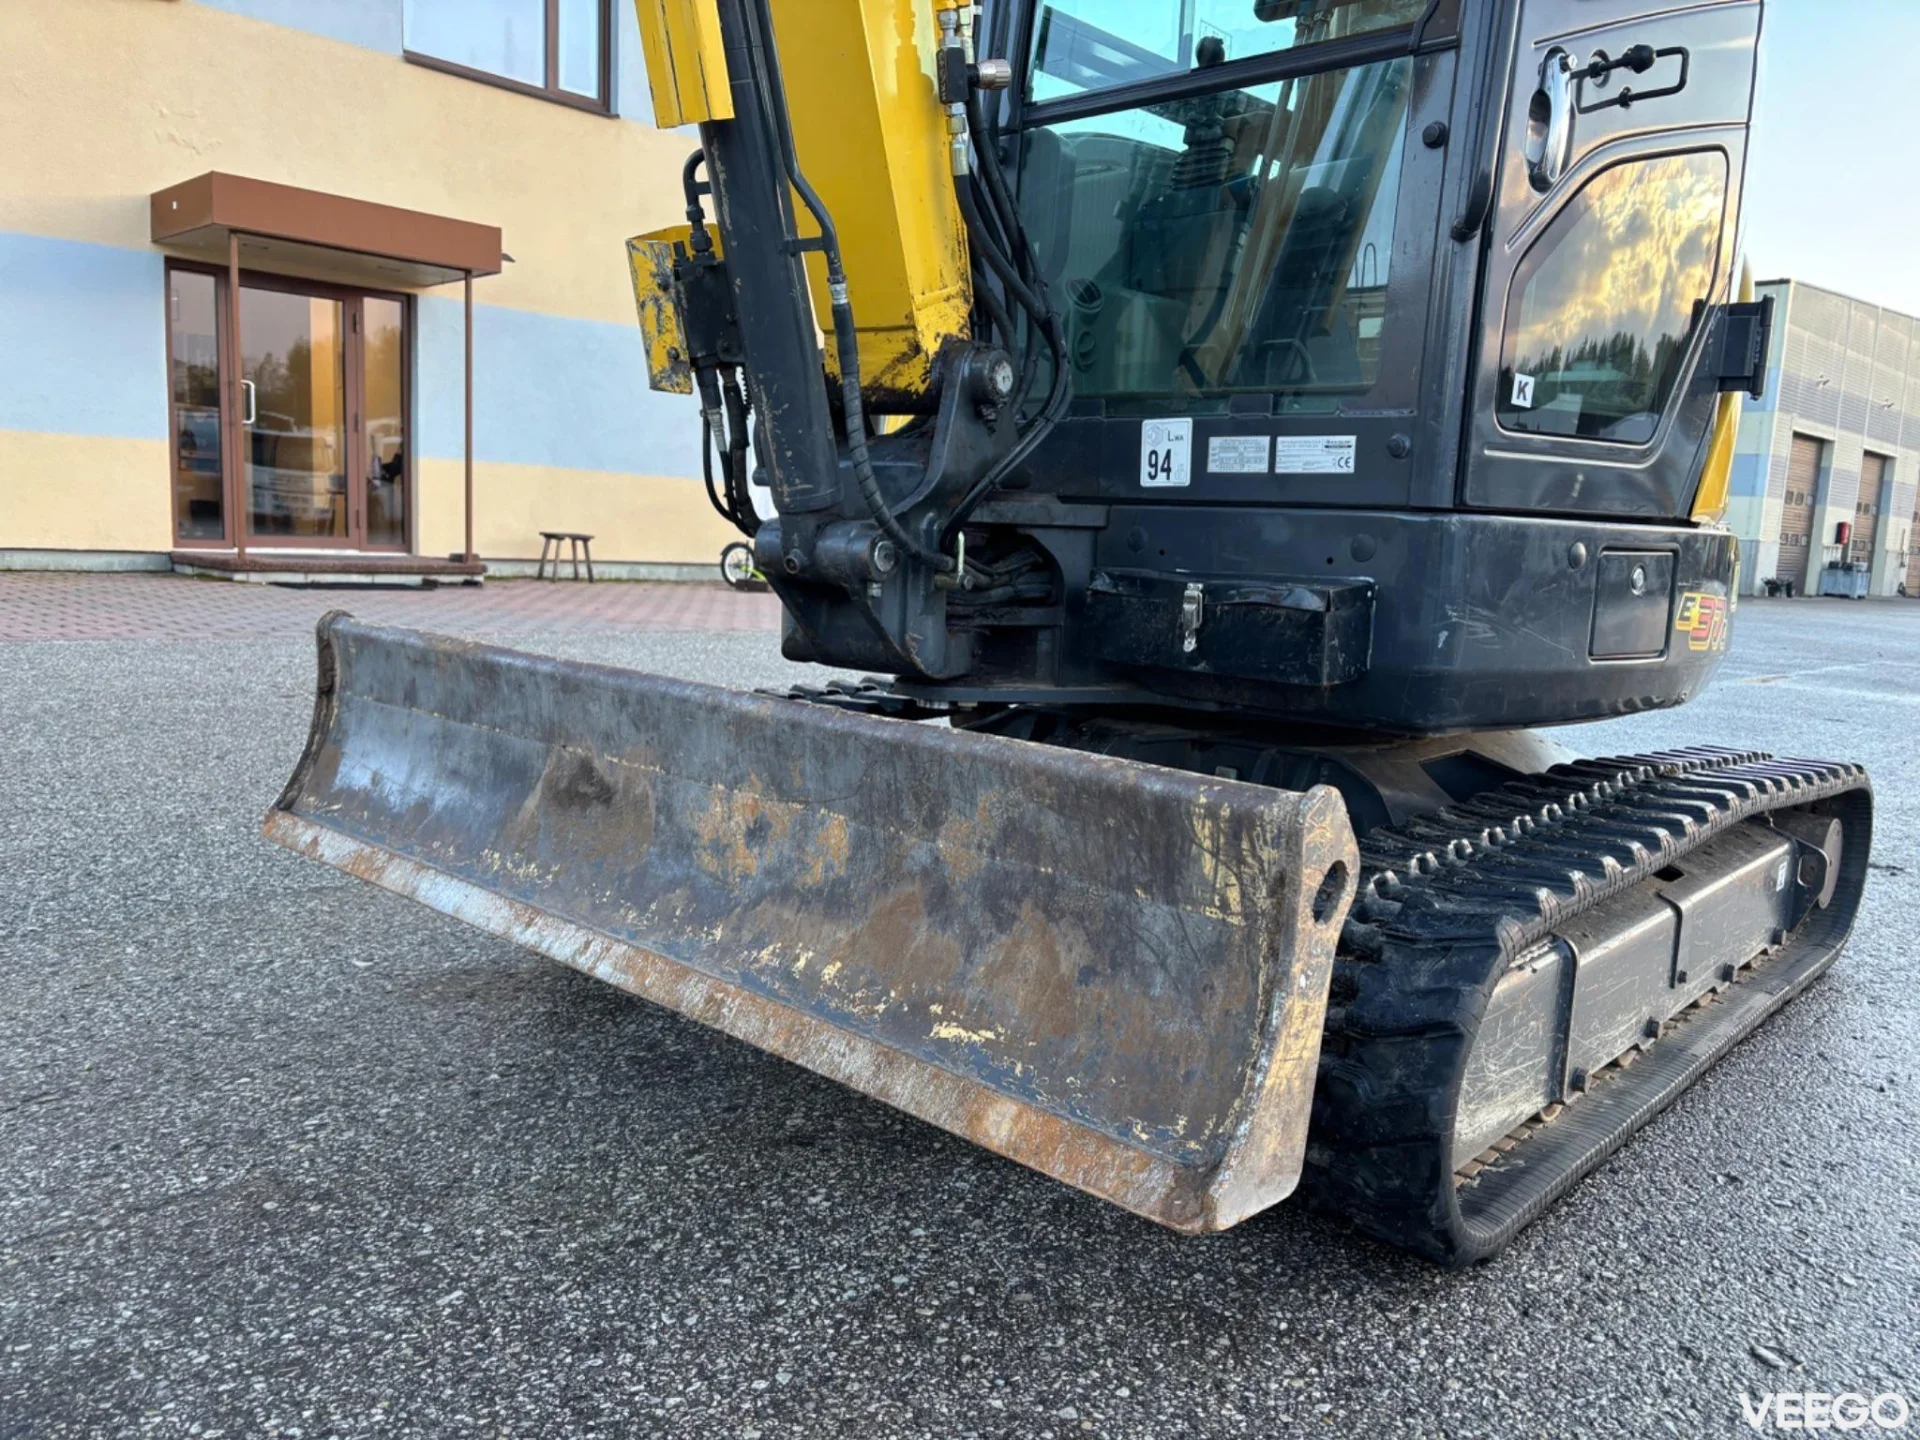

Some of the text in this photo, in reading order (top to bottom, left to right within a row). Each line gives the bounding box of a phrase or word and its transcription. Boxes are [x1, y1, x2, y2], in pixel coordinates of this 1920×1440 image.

[1516, 380, 1530, 402] K
[1148, 448, 1172, 481] 94
[1337, 456, 1352, 469] CE
